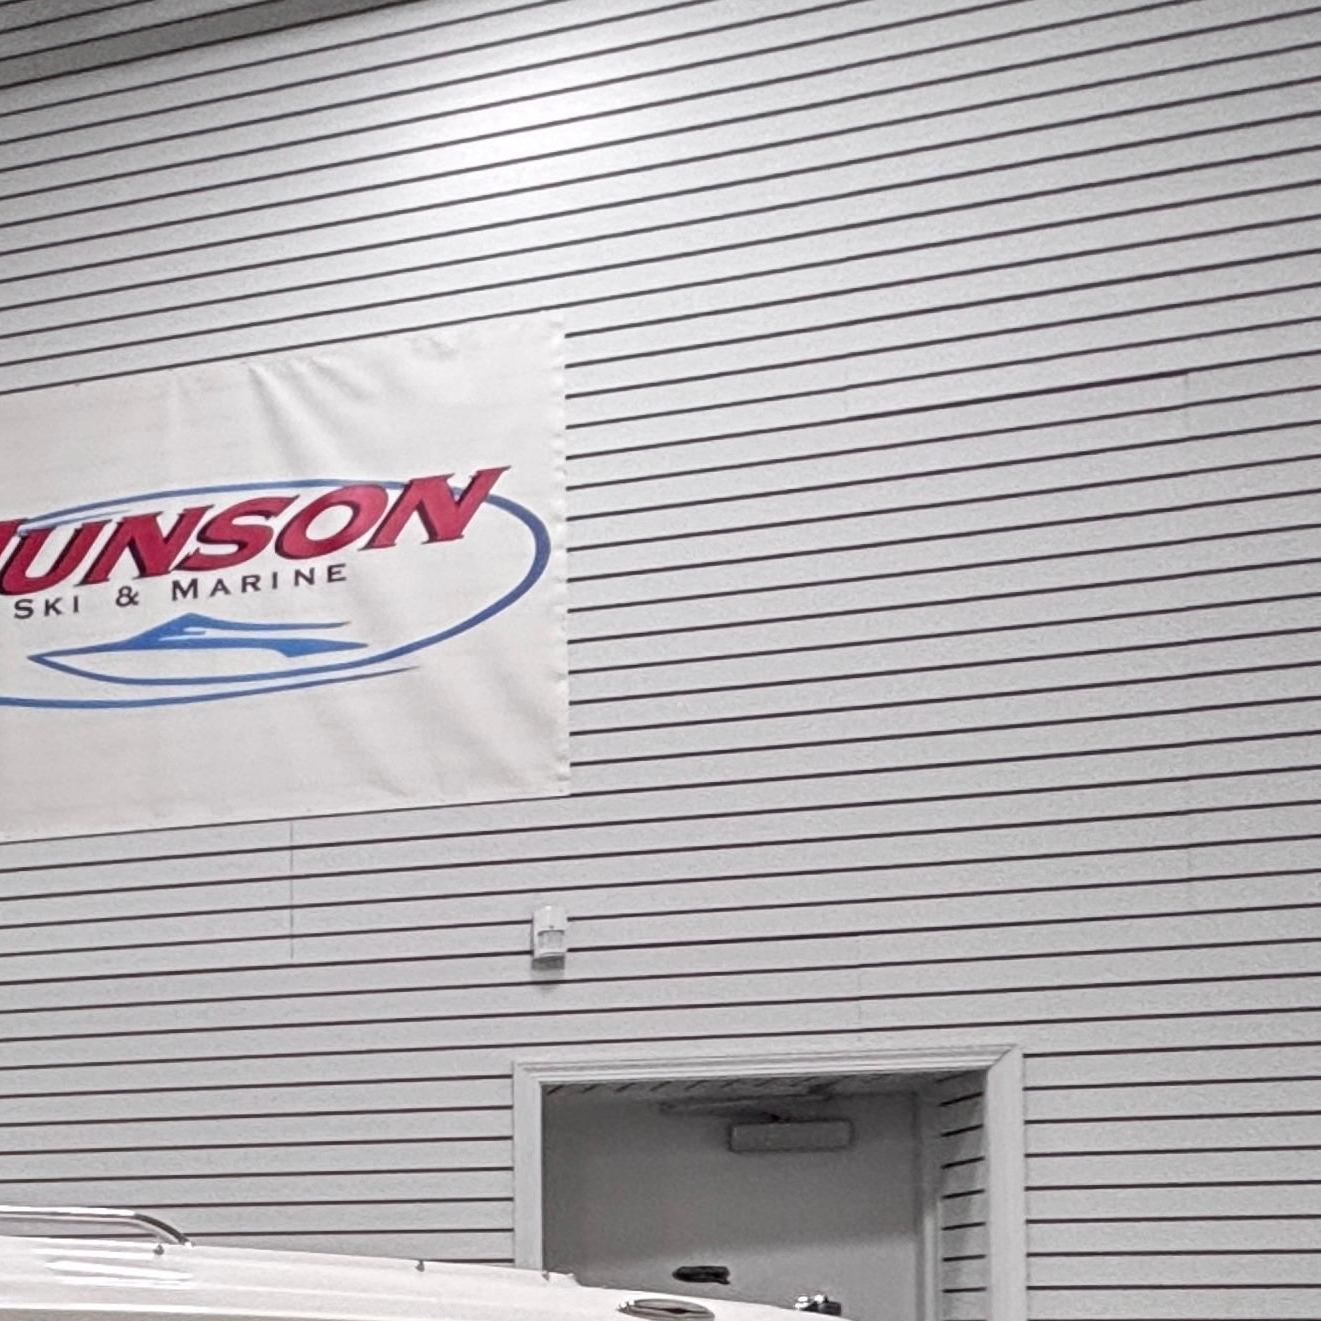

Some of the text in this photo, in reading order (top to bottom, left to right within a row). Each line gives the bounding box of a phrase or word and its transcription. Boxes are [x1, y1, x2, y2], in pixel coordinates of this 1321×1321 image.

[13, 562, 348, 620] SKI & MARINE
